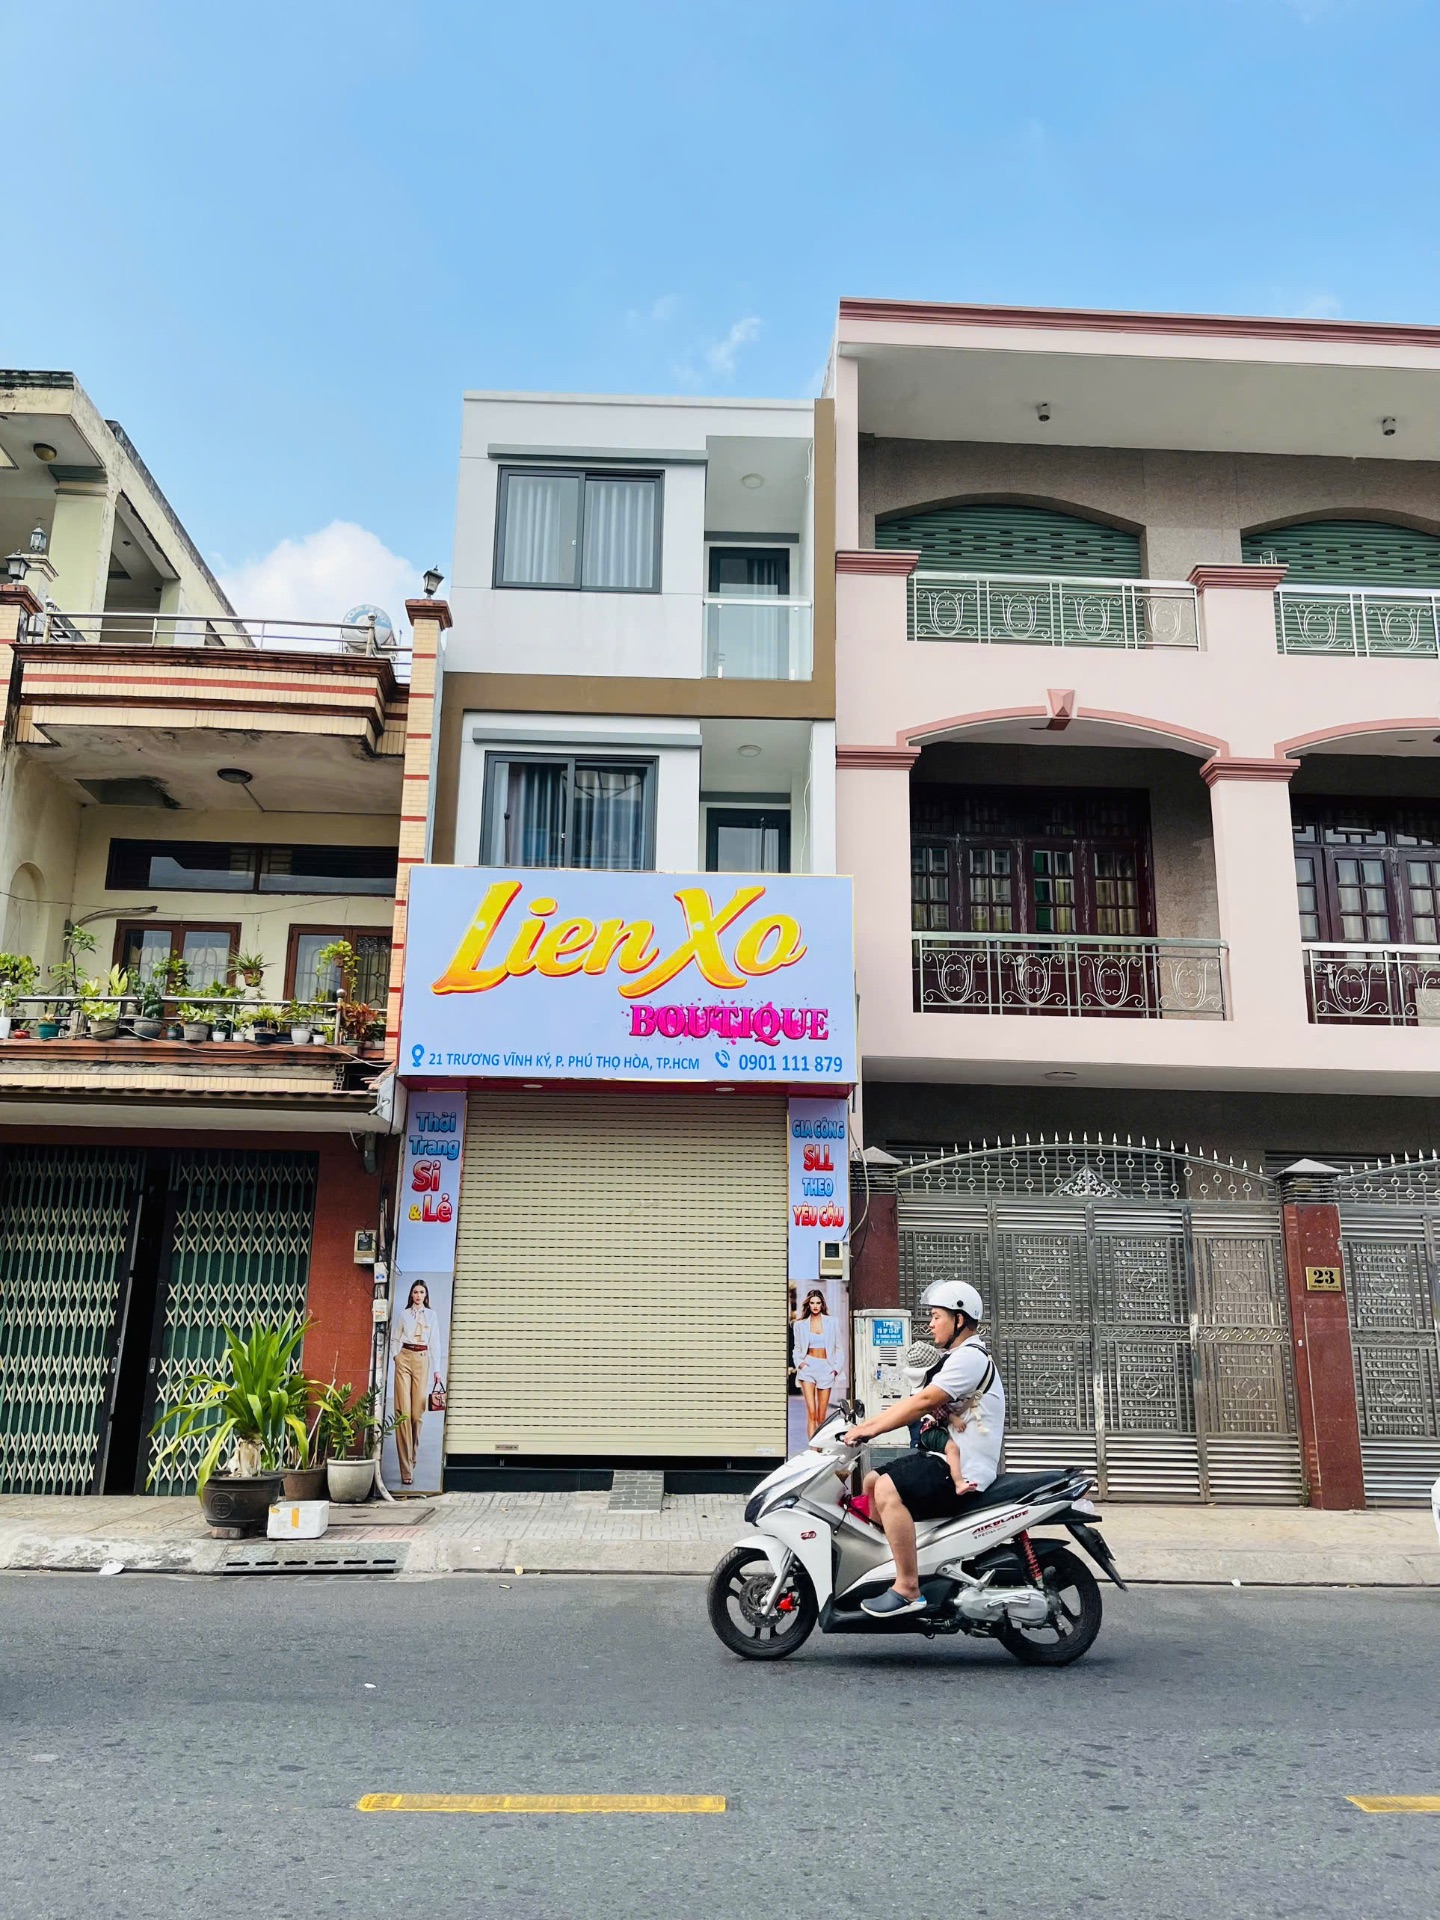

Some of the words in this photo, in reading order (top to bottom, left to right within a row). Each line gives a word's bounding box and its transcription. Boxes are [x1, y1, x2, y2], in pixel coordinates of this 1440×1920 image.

[629, 1004, 829, 1046] BOUTIQUE
[428, 1053, 443, 1065] 21
[447, 1053, 500, 1066] TRƯƠNG
[503, 1051, 533, 1066] VĨNH
[536, 1052, 551, 1068] KÝ,
[556, 1055, 565, 1067] P.
[568, 1053, 592, 1067] PHÚ
[596, 1056, 621, 1071] THỌ
[623, 1054, 653, 1070] HÒA,
[656, 1057, 700, 1070] TP.HCM
[739, 1054, 777, 1071] 0901
[782, 1055, 810, 1071] 111
[814, 1056, 843, 1072] 879
[416, 1111, 457, 1133] Thời
[792, 1119, 813, 1138] GIA
[814, 1117, 845, 1139] CÔNG
[409, 1135, 460, 1160] Trang
[803, 1143, 834, 1172] SLL
[412, 1160, 441, 1192] Sỉ
[802, 1177, 834, 1198] THEO
[409, 1204, 422, 1221] &
[422, 1193, 453, 1222] Lẻ
[792, 1201, 818, 1226] YÊU
[1313, 1269, 1335, 1284] 23
